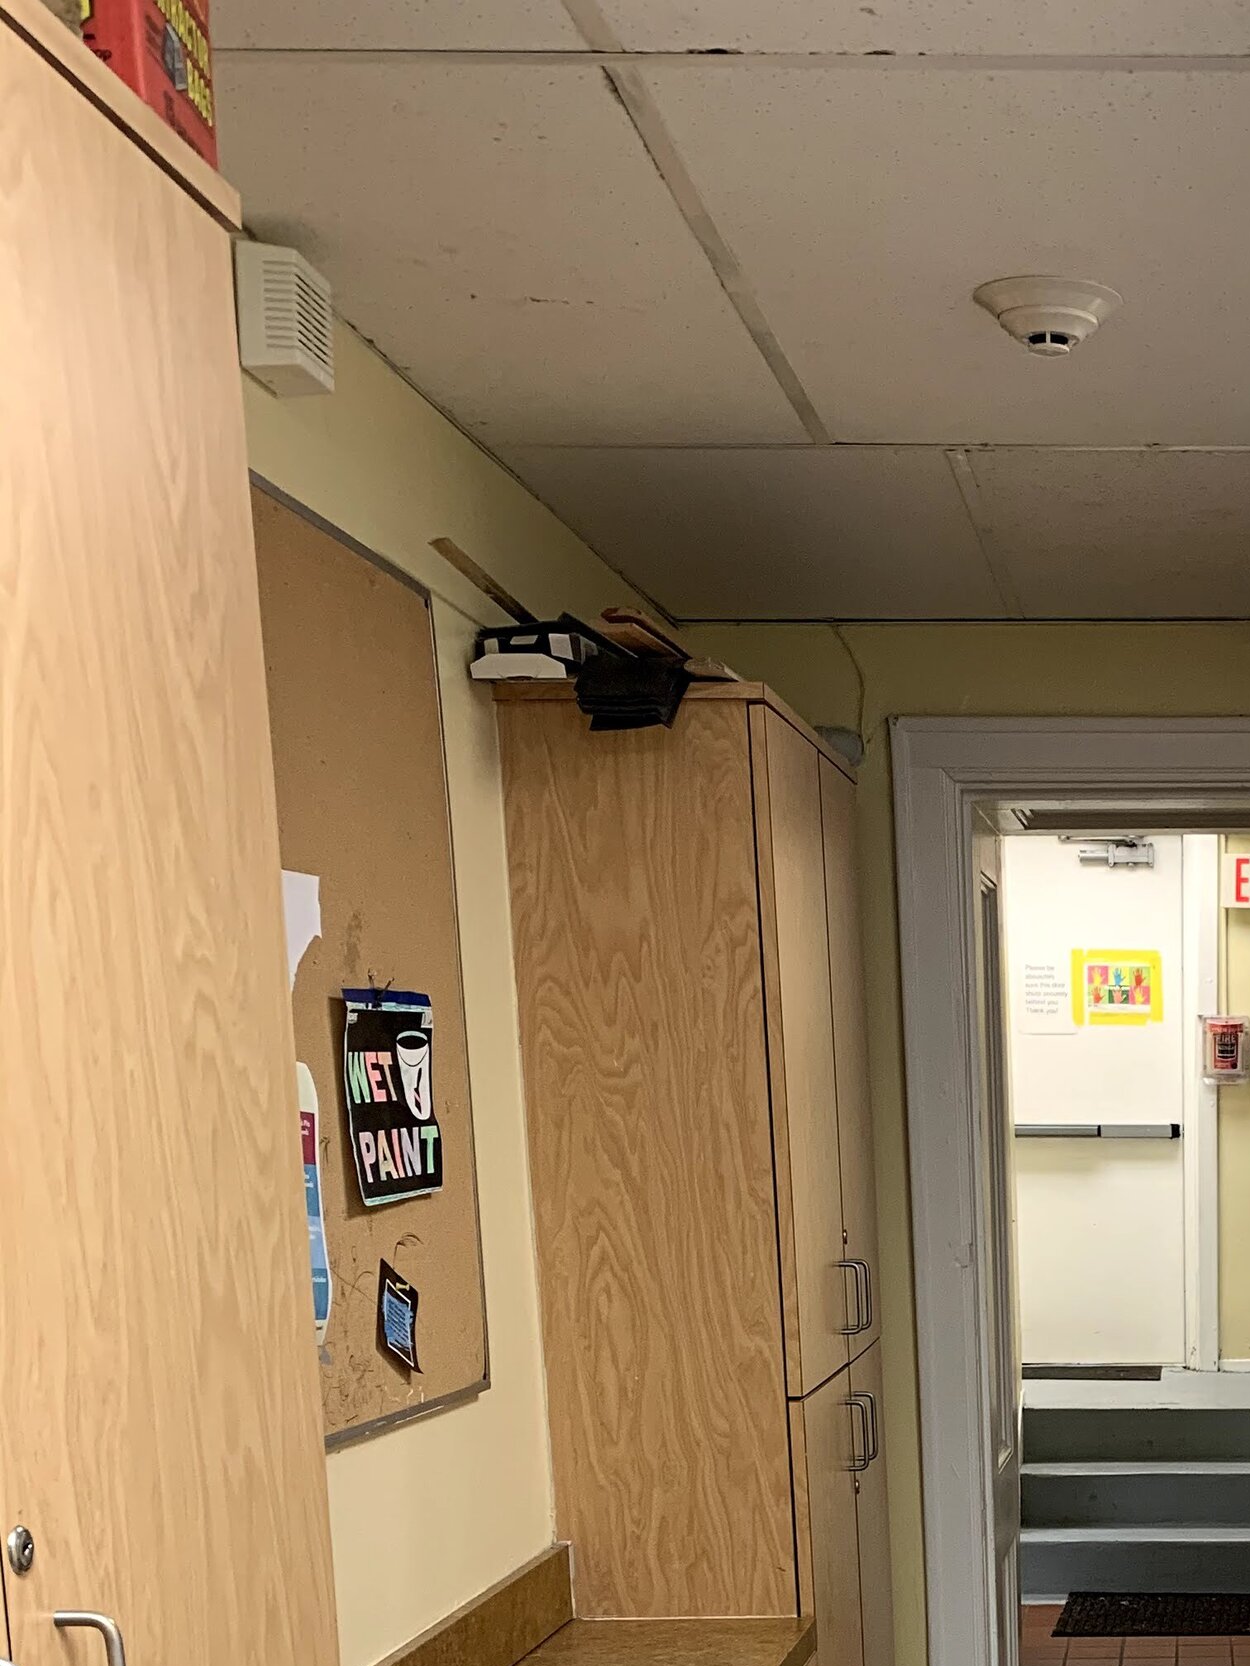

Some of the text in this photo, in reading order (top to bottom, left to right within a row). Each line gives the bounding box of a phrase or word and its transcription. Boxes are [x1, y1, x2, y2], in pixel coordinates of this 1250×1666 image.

[1215, 1033, 1236, 1043] FIRE
[346, 1051, 398, 1105] WET
[358, 1125, 439, 1183] PAINT
